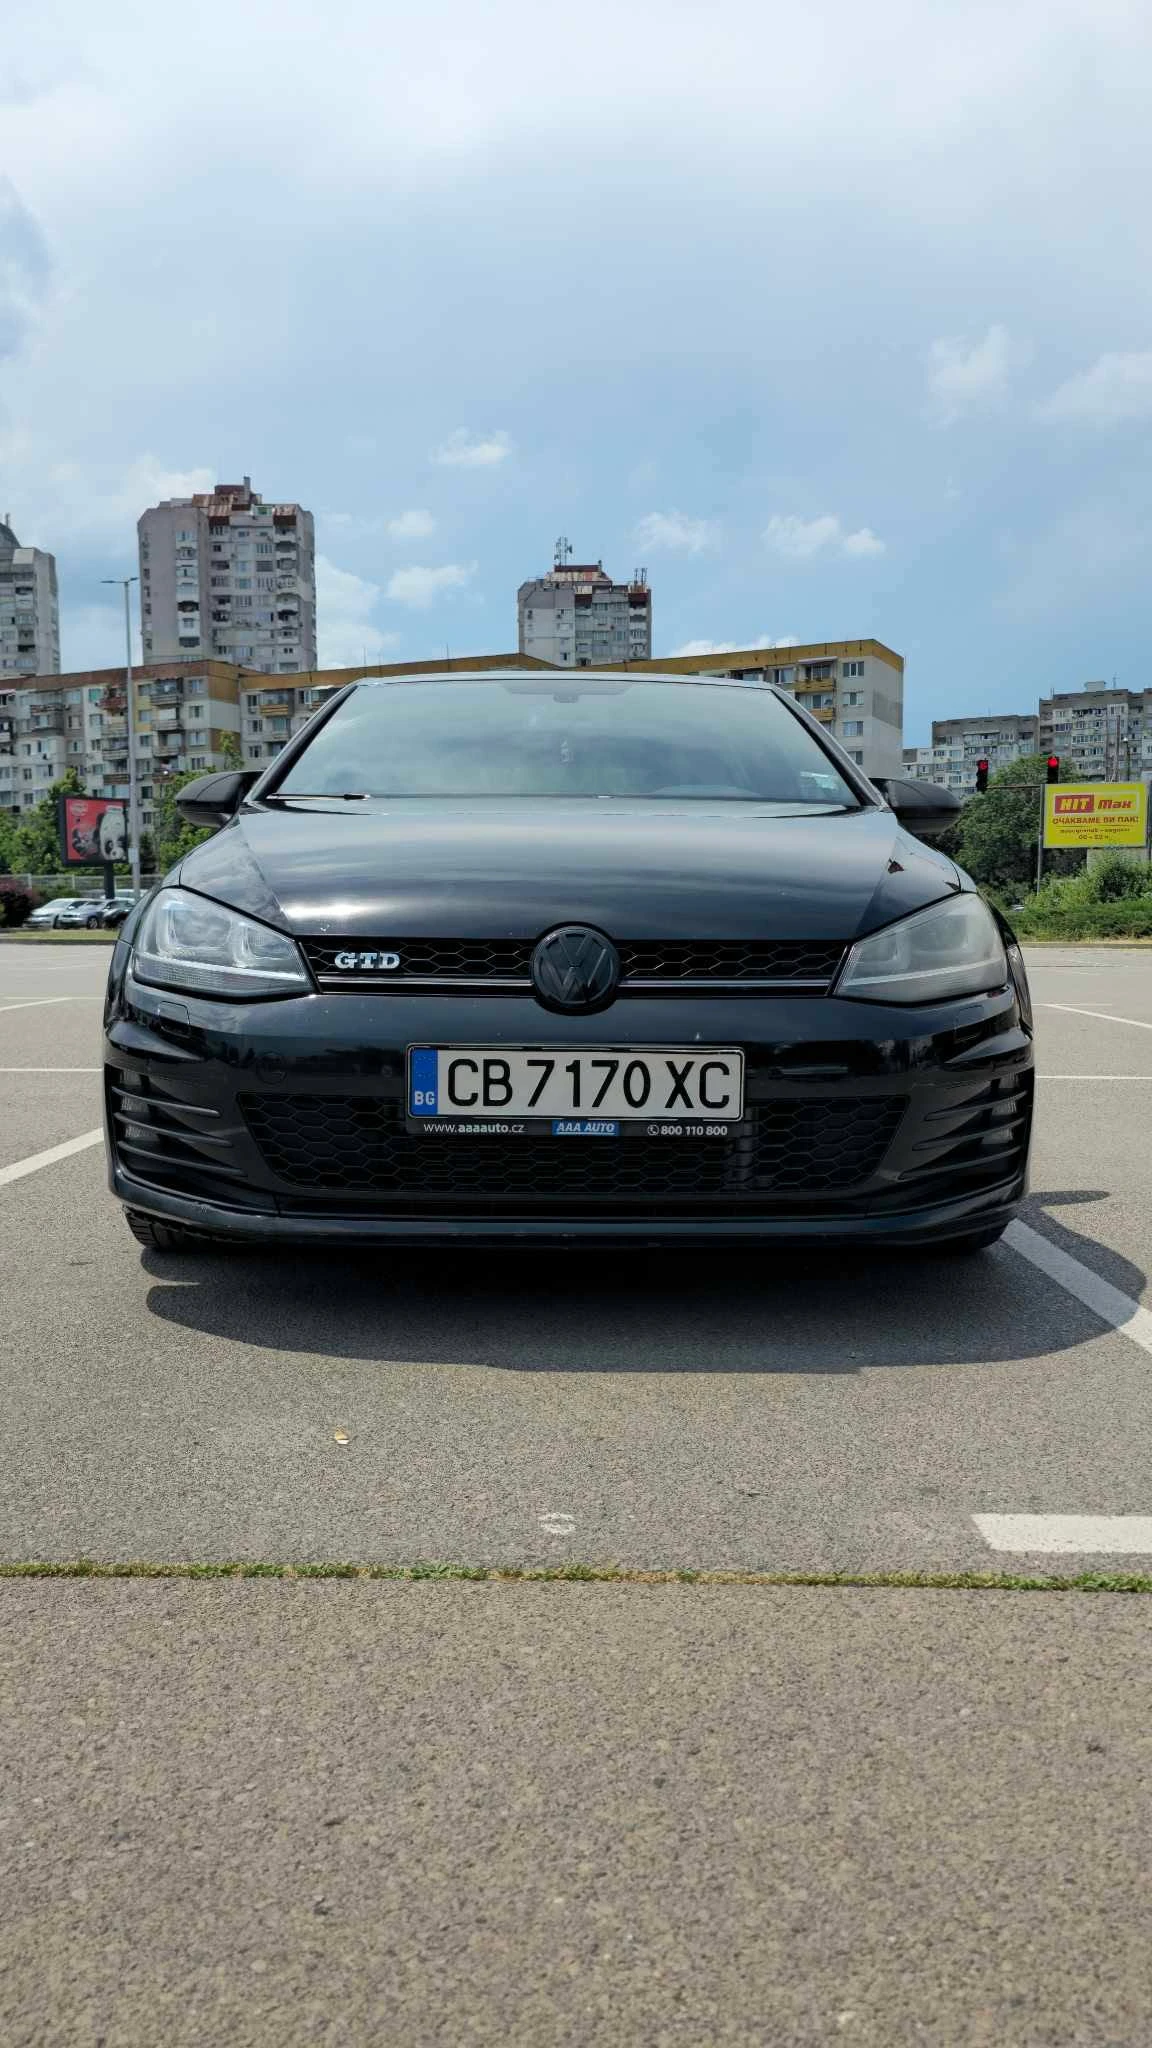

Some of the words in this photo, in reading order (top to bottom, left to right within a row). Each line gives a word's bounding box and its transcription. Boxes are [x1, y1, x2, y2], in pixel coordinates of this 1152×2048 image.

[1059, 798, 1090, 811] HIT
[334, 951, 400, 969] GTD
[447, 1058, 514, 1107] CB
[526, 1059, 651, 1109] 7170
[664, 1060, 730, 1109] XC
[413, 1090, 436, 1106] BG
[423, 1123, 525, 1134] www.aaaauto.cz
[556, 1123, 583, 1133] AAA
[584, 1123, 616, 1133] AUTO
[660, 1125, 683, 1136] 800
[685, 1126, 704, 1136] 110
[706, 1125, 728, 1136] 800
